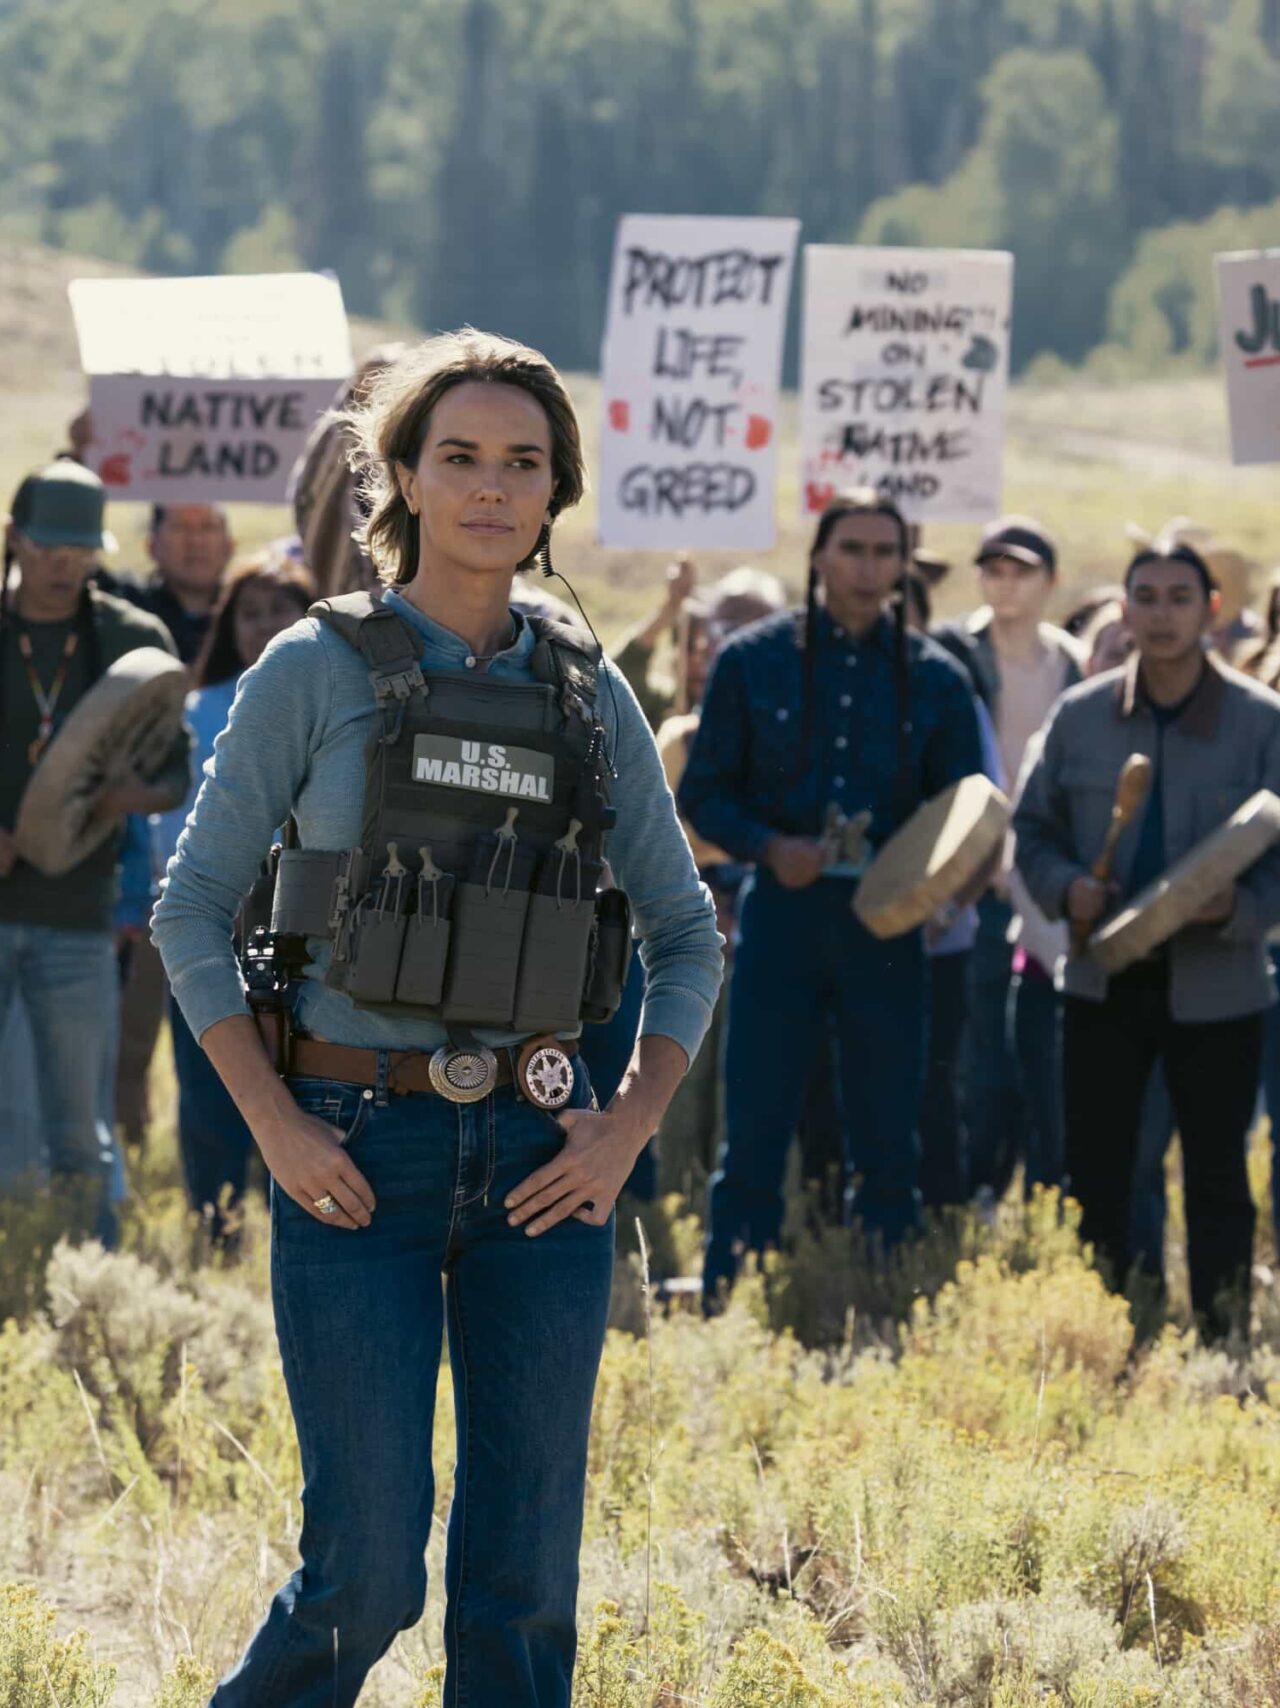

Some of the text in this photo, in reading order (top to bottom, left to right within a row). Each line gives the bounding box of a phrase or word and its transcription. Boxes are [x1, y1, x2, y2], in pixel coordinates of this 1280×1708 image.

[624, 246, 785, 318] PROTECT
[885, 271, 928, 294] NO
[843, 304, 964, 336] MINING
[881, 342, 925, 369] ON
[140, 390, 306, 430] NATIVE
[818, 375, 984, 414] STOLEN
[651, 396, 740, 448] NOT
[158, 439, 280, 478] LAND
[619, 461, 758, 516] GREED
[461, 740, 512, 769] U.S.
[416, 757, 550, 800] MARSHAL
